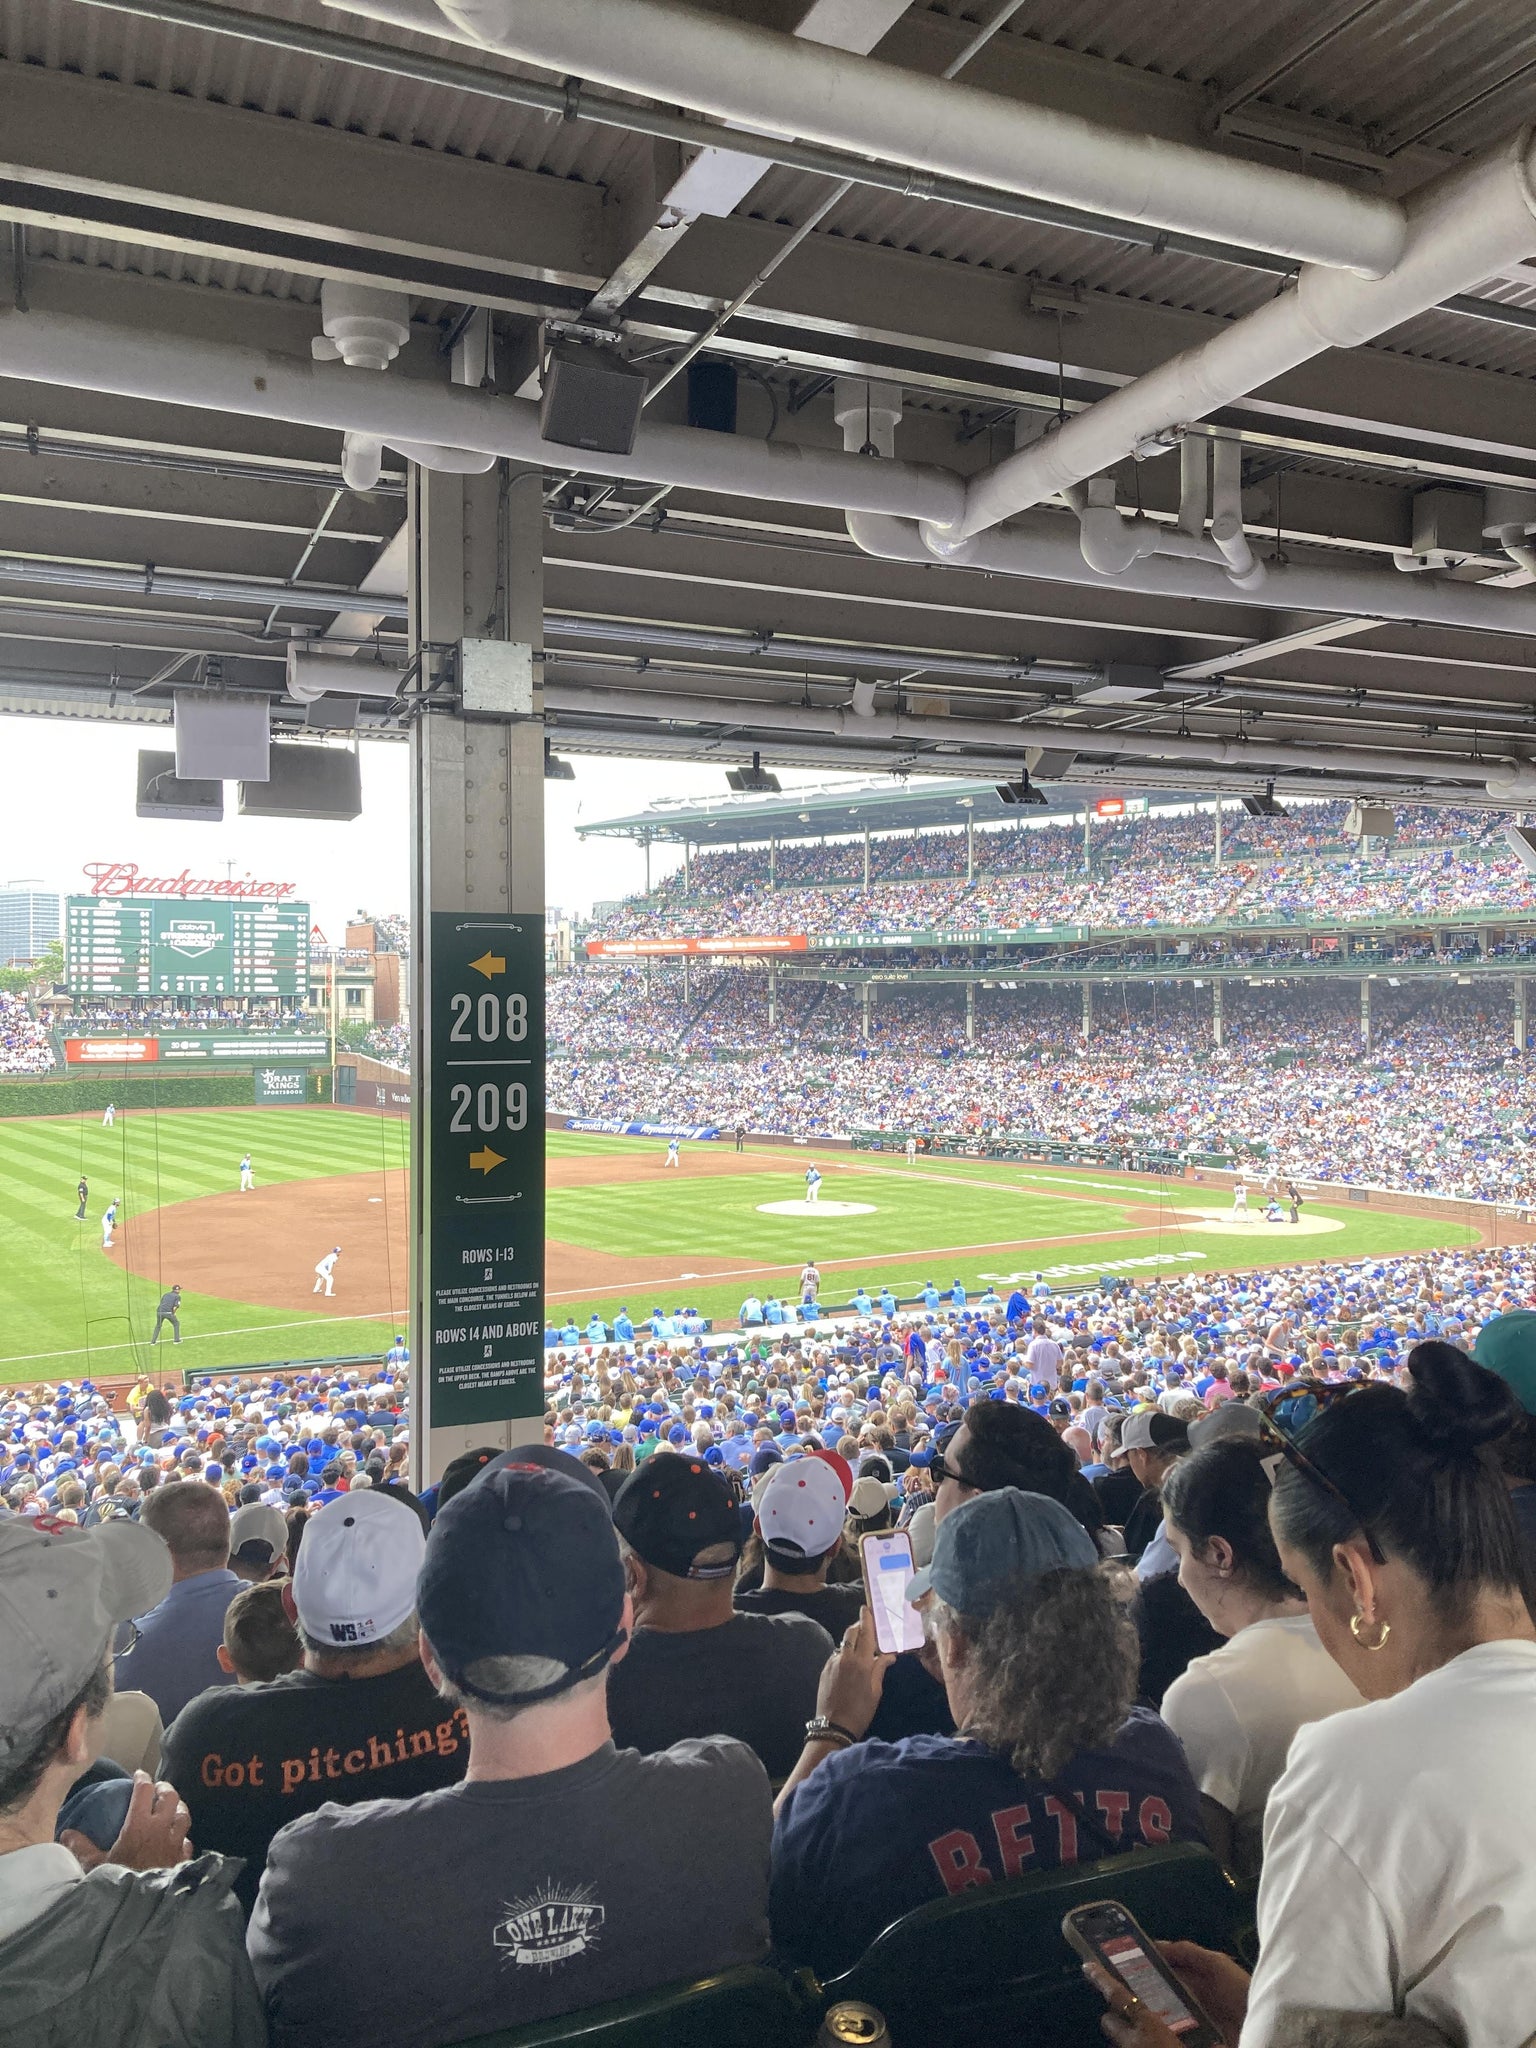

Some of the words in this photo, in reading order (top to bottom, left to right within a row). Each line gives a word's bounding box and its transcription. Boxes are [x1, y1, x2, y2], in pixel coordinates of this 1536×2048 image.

[82, 862, 296, 897] Budweiser
[882, 936, 912, 944] CHAPMAN
[160, 982, 168, 991] 4
[450, 993, 528, 1042] 208
[264, 1073, 301, 1083] DRAFT
[268, 1081, 300, 1089] KINGS
[450, 1082, 528, 1132] 209
[573, 1120, 602, 1131] Reynolds
[602, 1122, 620, 1133] Wrap
[641, 1124, 673, 1135] Reynolds
[674, 1126, 694, 1138] Wrap
[462, 1249, 493, 1264] ROWS
[496, 1247, 514, 1261] 1-13
[977, 1252, 1192, 1284] Southwest
[436, 1328, 466, 1344] ROWS
[470, 1326, 479, 1341] 14
[482, 1324, 503, 1340] AND
[506, 1322, 539, 1337] ABOVE
[472, 1362, 500, 1370] CONCESSIONS
[511, 1359, 535, 1367] RESTROOMS
[459, 1381, 477, 1390] CLOSEST
[330, 1624, 357, 1641] WS
[202, 1753, 264, 1787] Got
[280, 1707, 470, 1794] pitching?
[506, 1912, 543, 1942] ONE
[547, 1906, 593, 1936] LAKE
